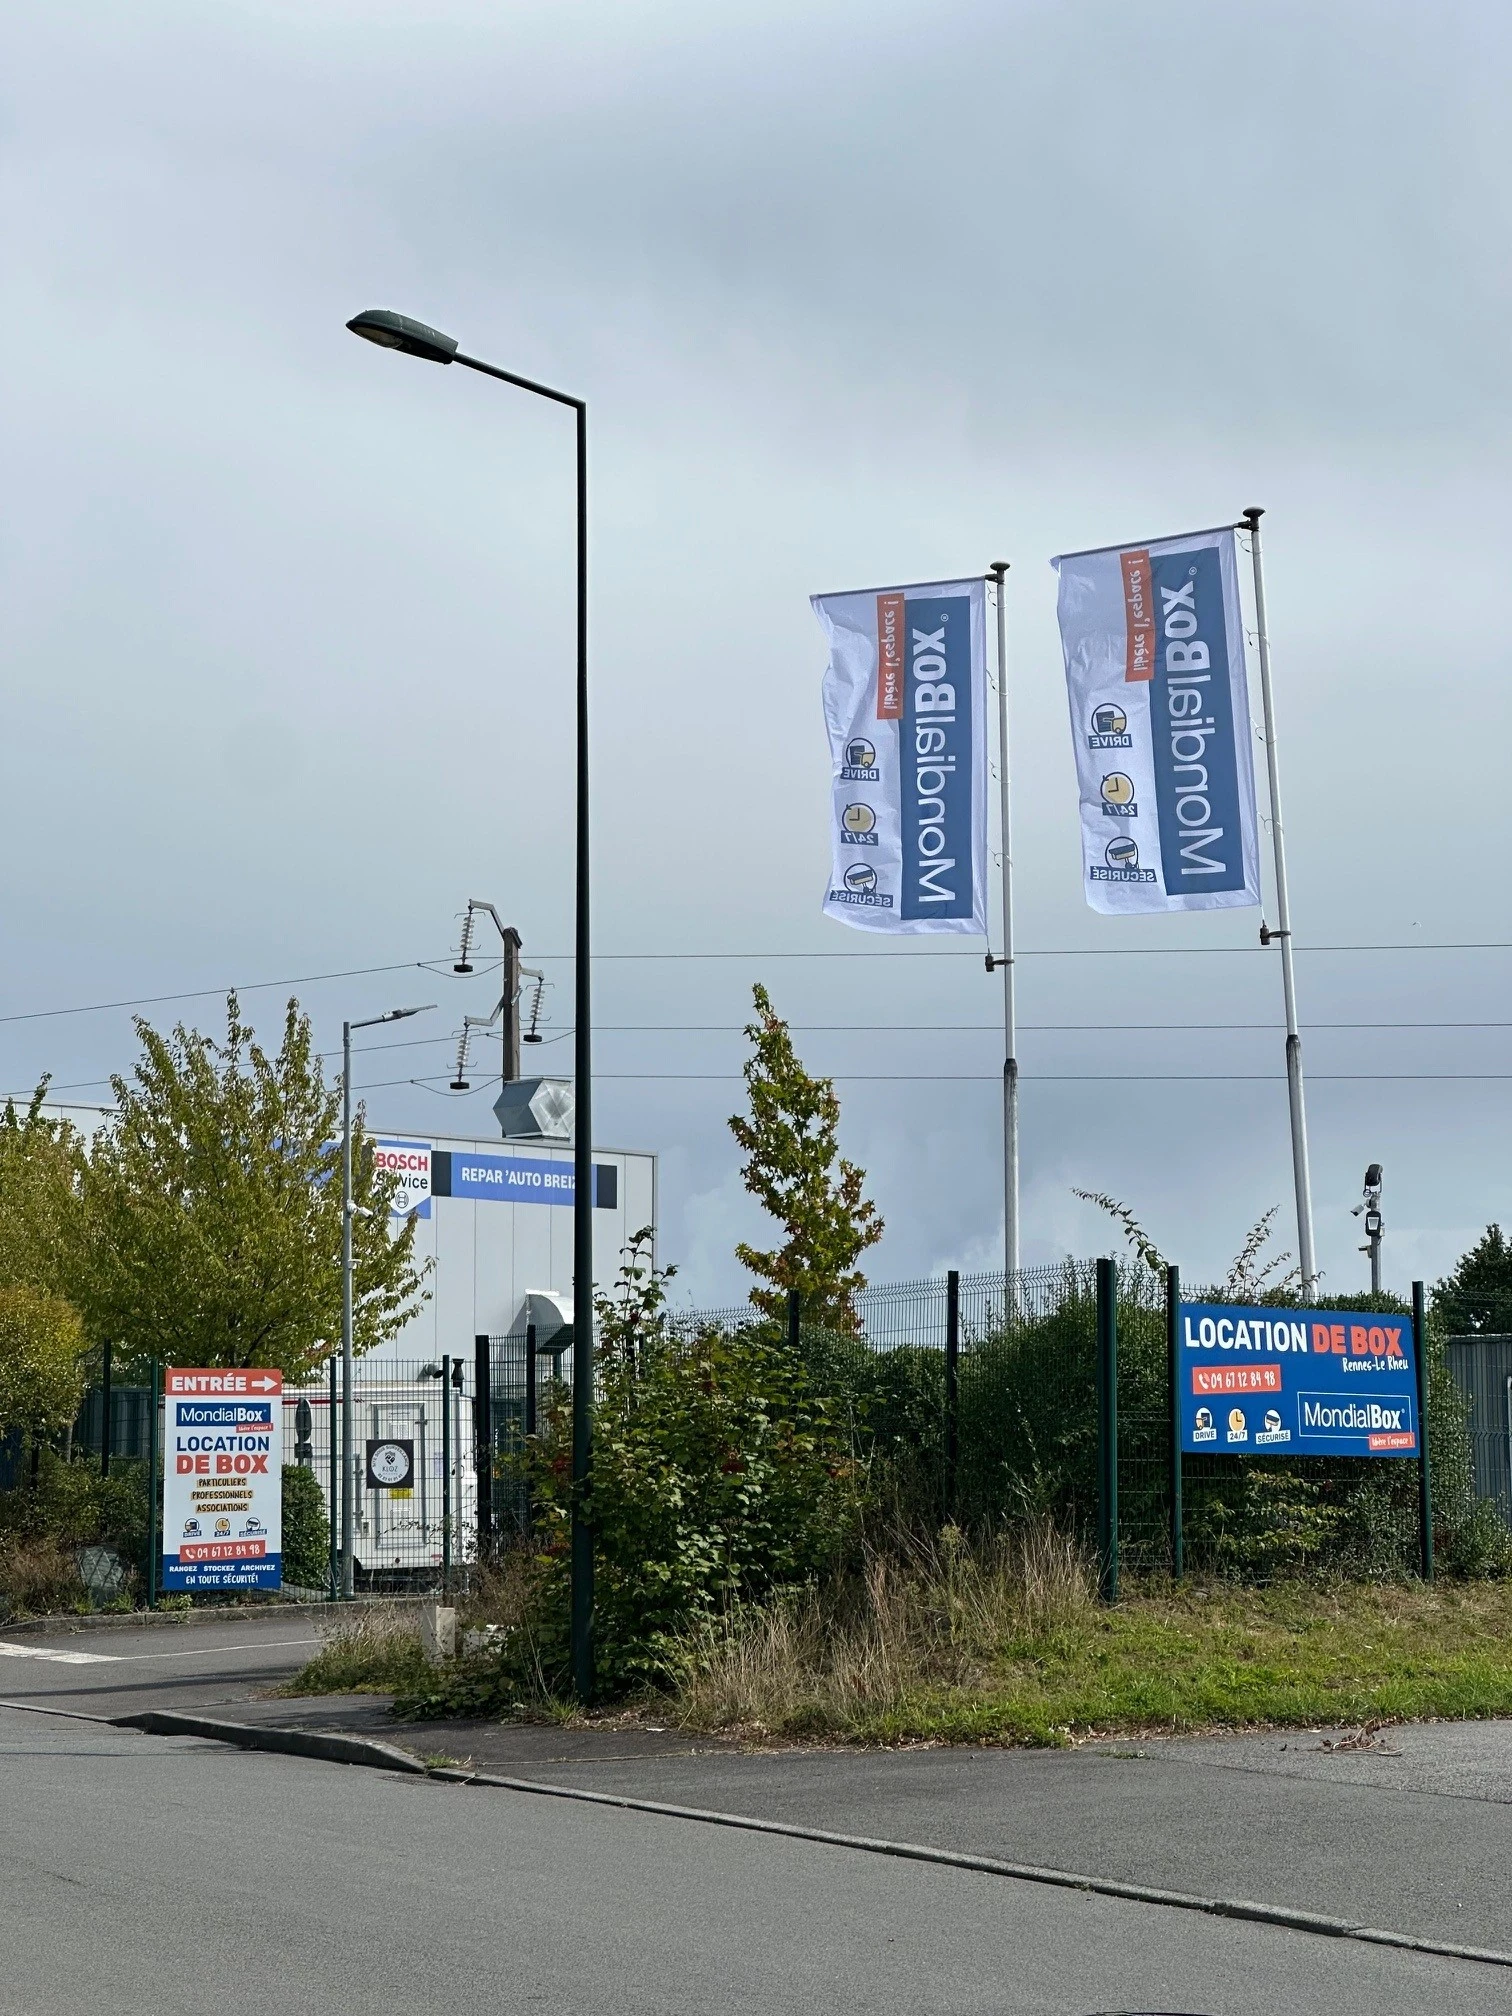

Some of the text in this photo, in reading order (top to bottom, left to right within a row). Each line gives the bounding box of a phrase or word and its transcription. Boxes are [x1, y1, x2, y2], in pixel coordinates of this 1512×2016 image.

[376, 1152, 428, 1171] BOSCH
[376, 1171, 428, 1189] Svice
[461, 1166, 503, 1184] REPAR
[1184, 1316, 1404, 1357] LOCATION DE BOX
[1342, 1355, 1409, 1373] Rennes-Le Rheu
[171, 1372, 247, 1392] ENTRÉE
[1210, 1370, 1276, 1389] 09 67 12 84 98
[181, 1407, 263, 1422] MondialBox
[1304, 1401, 1402, 1429] MondialBox
[1194, 1431, 1215, 1440] DRIVE
[1229, 1431, 1246, 1440] 24/7
[1257, 1432, 1289, 1443] SÉCURISÉ
[176, 1436, 270, 1452] LOCATION
[176, 1454, 269, 1475] DE BOX
[198, 1478, 247, 1487] PARTICULIERS
[192, 1490, 253, 1500] PROFESSIONNELS
[196, 1502, 248, 1512] ASSOCIATIONS
[197, 1544, 260, 1559] 09 67 12 84 98
[185, 1575, 196, 1584] EN
[197, 1574, 220, 1584] TOUTE
